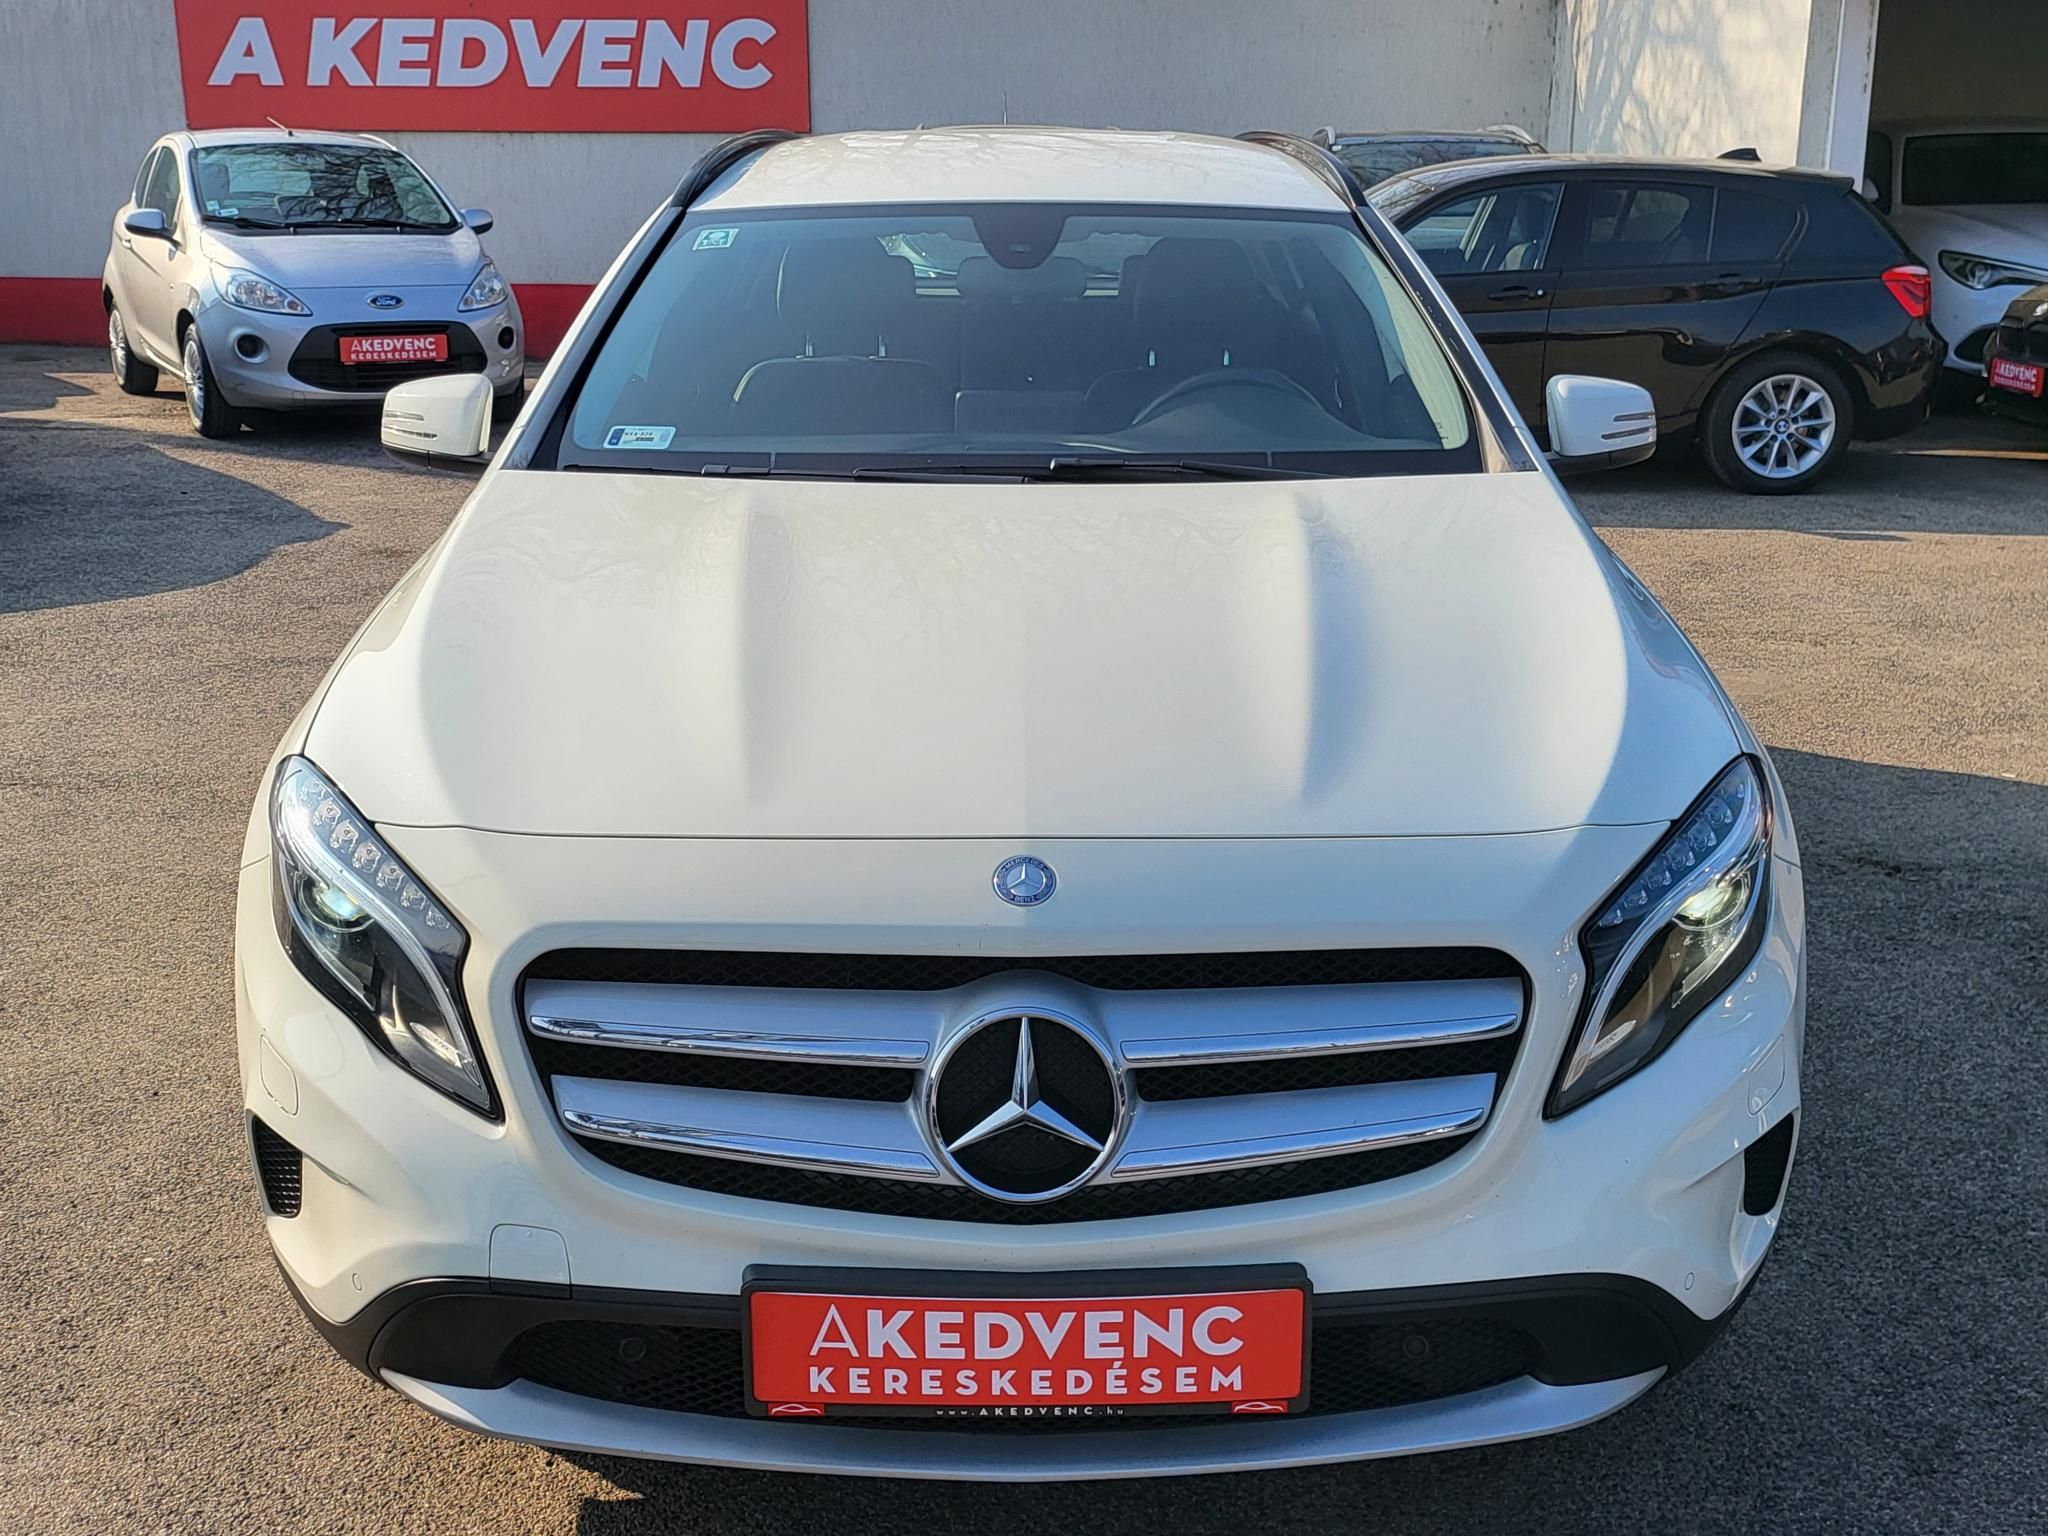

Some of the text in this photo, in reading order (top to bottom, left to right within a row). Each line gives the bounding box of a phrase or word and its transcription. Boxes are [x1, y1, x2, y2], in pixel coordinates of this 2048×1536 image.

[207, 17, 778, 89] A KEDVENC
[375, 296, 397, 306] Ford
[350, 337, 436, 352] AKEDVENC
[809, 1303, 1245, 1361] AKEDVENC
[809, 1361, 1244, 1397] KERESKEDÉSEM
[935, 1406, 1125, 1417] www.AKEDVENC.hu
